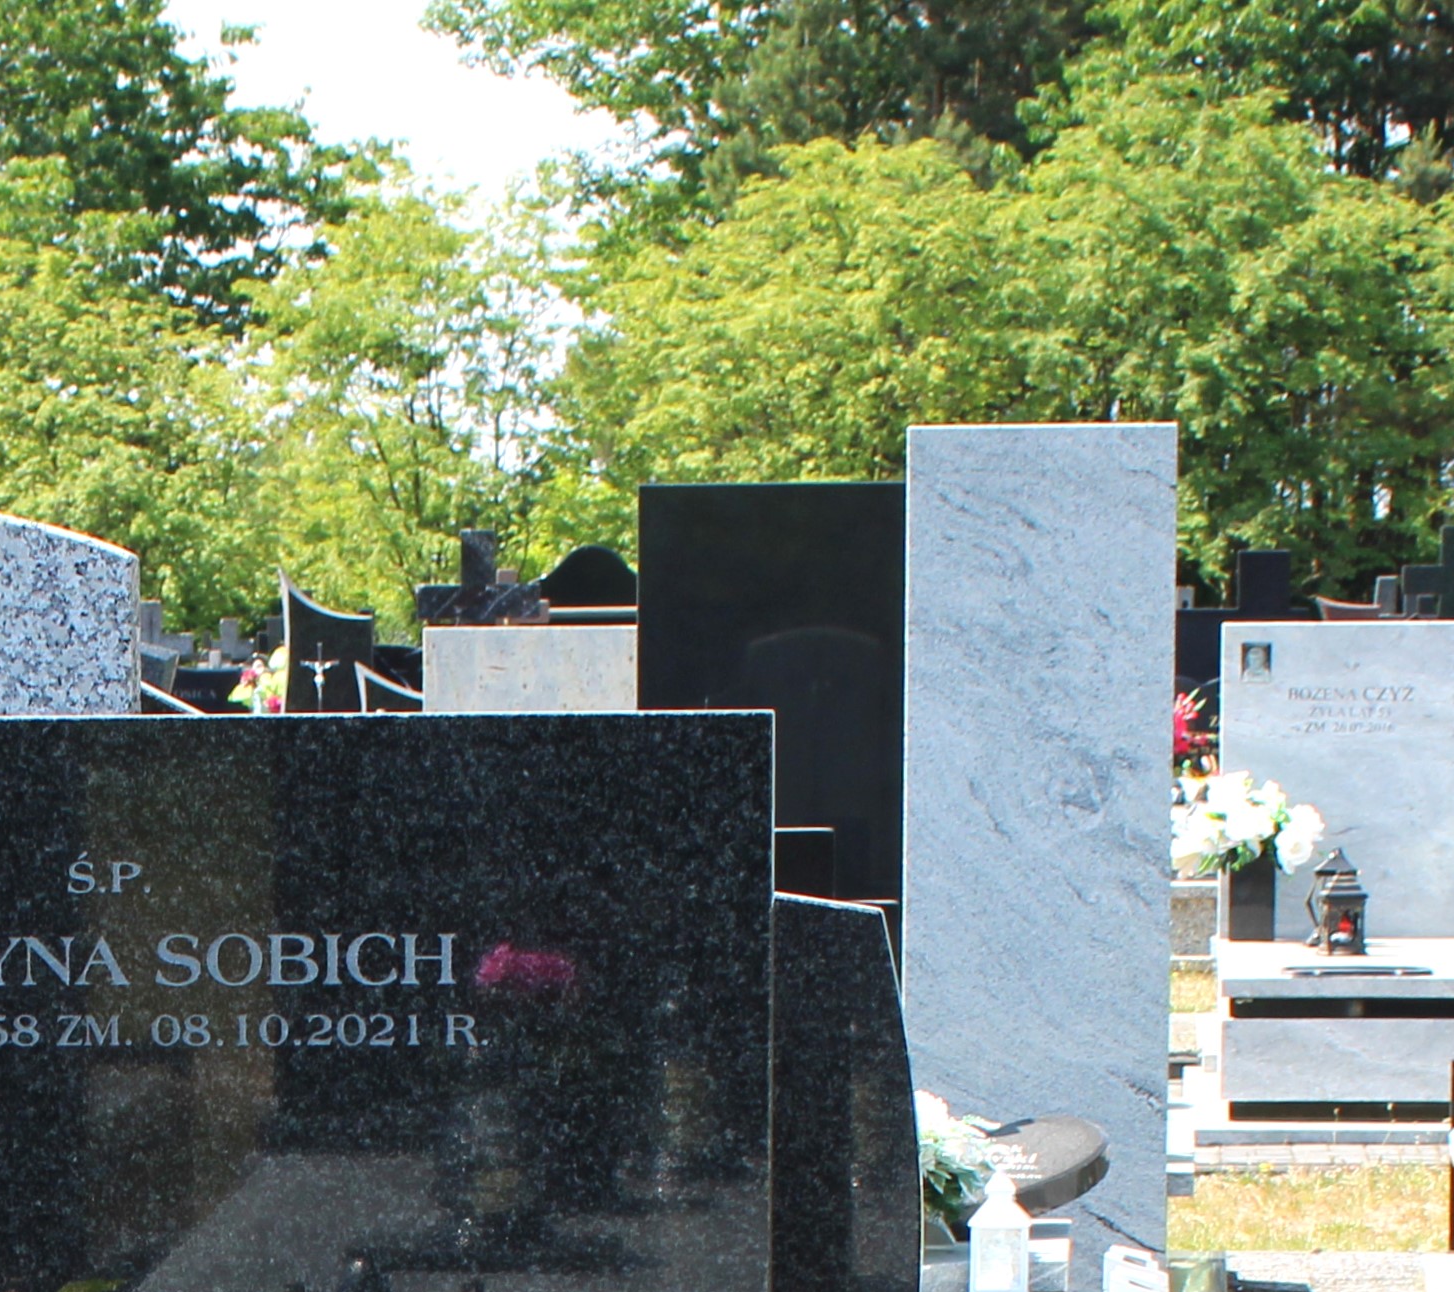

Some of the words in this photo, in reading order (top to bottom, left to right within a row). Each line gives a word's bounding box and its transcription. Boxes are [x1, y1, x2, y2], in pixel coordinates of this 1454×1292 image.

[67, 851, 151, 894] Ś.P.
[155, 932, 457, 987] SOBICH
[56, 1014, 133, 1047] ZM.
[151, 1013, 419, 1047] 08.10.2021
[445, 1014, 489, 1047] R.
